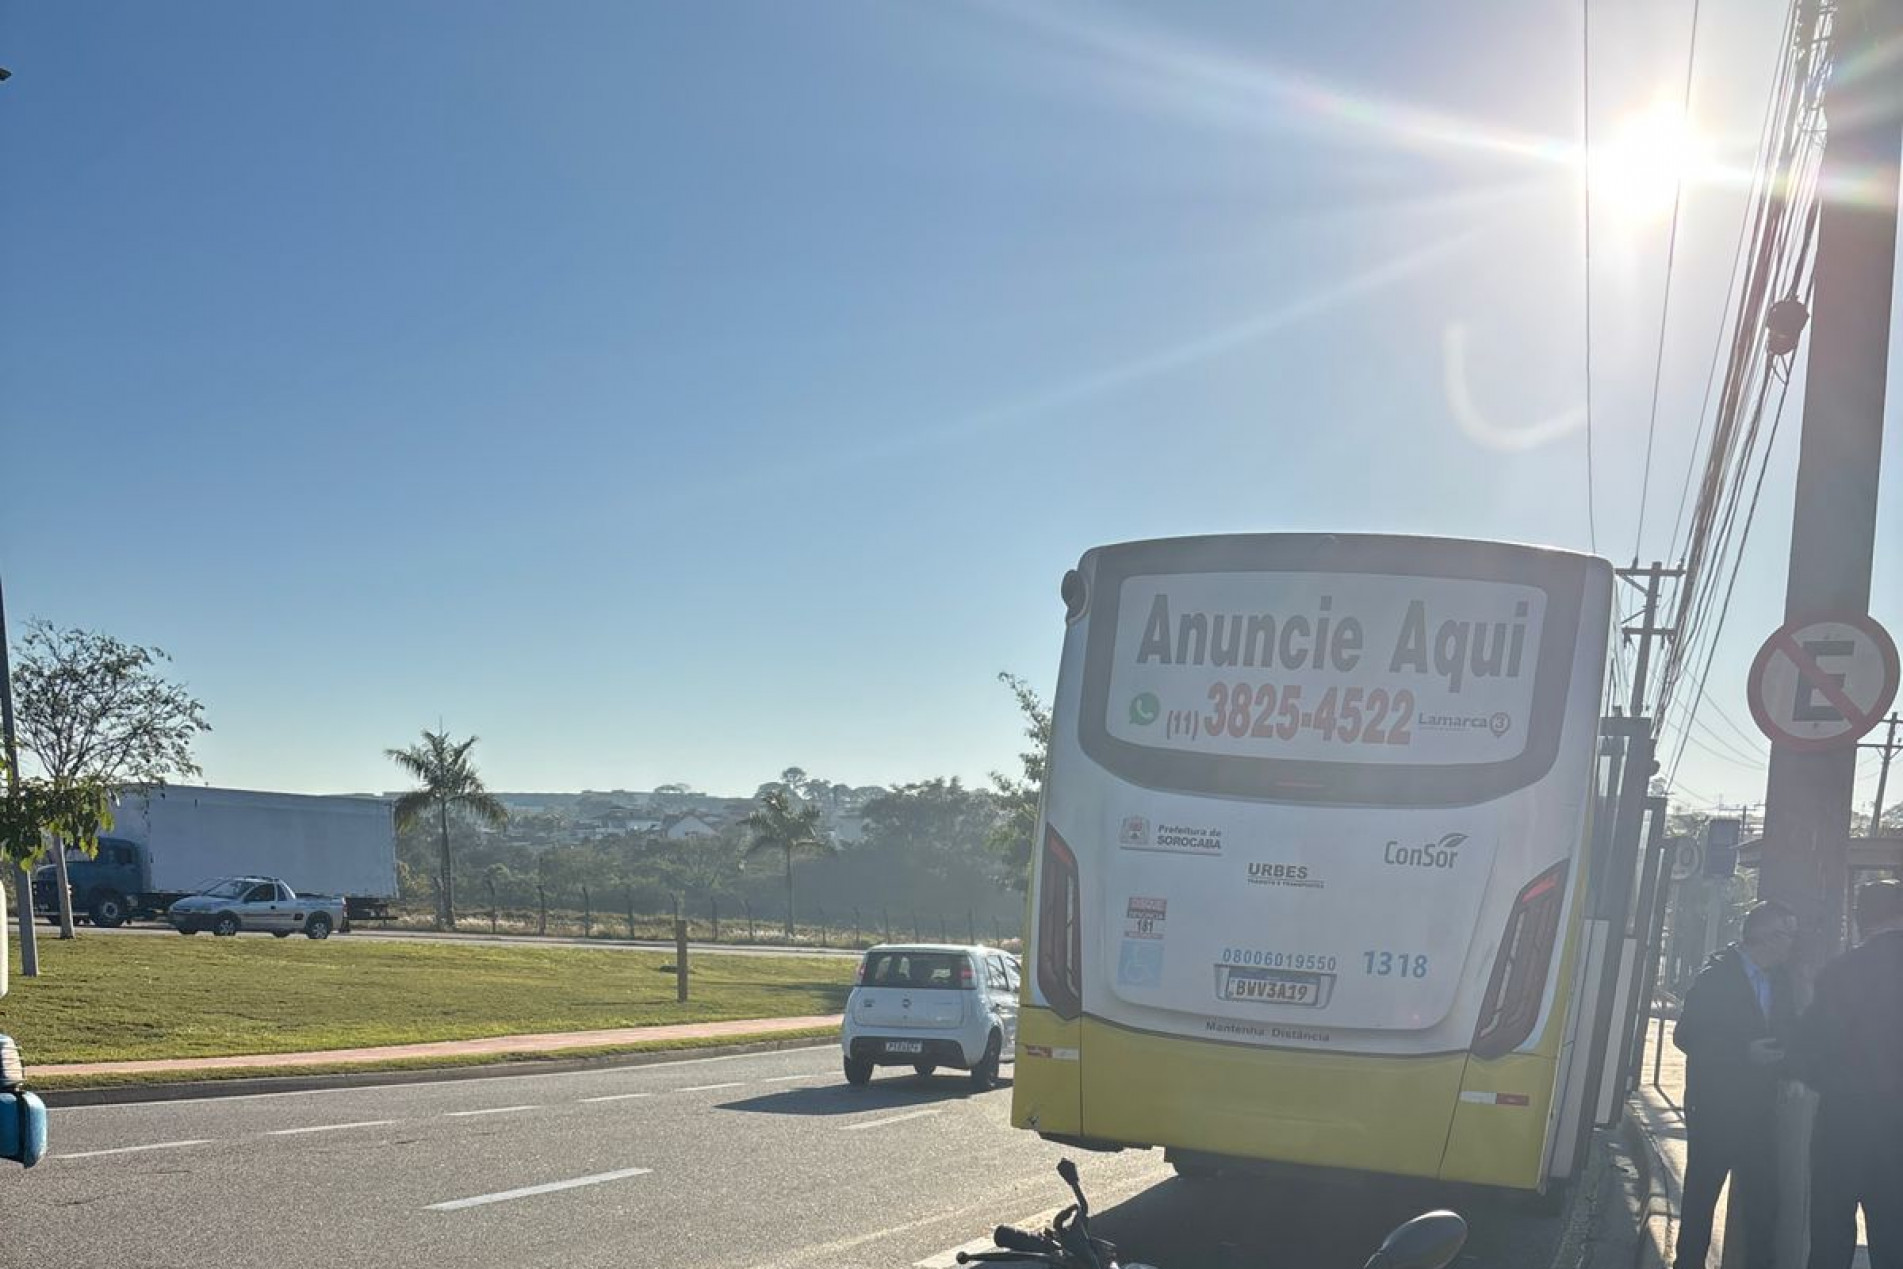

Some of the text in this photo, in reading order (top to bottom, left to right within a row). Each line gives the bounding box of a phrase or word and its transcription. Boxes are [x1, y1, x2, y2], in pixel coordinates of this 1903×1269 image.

[1136, 594, 1529, 694] Anuncie Aqui
[1792, 640, 1854, 722] E
[1166, 681, 1415, 746] (11) 3825-4522
[1418, 712, 1488, 729] Lamarca
[1158, 824, 1221, 837] Prefeitura de
[1157, 835, 1222, 850] SOROCABA
[1384, 840, 1458, 869] ConSor
[1247, 862, 1308, 880] URBES
[1223, 948, 1337, 971] 08006019550
[1363, 951, 1428, 978] 1318
[1206, 1020, 1330, 1042] Mantenha Distância
